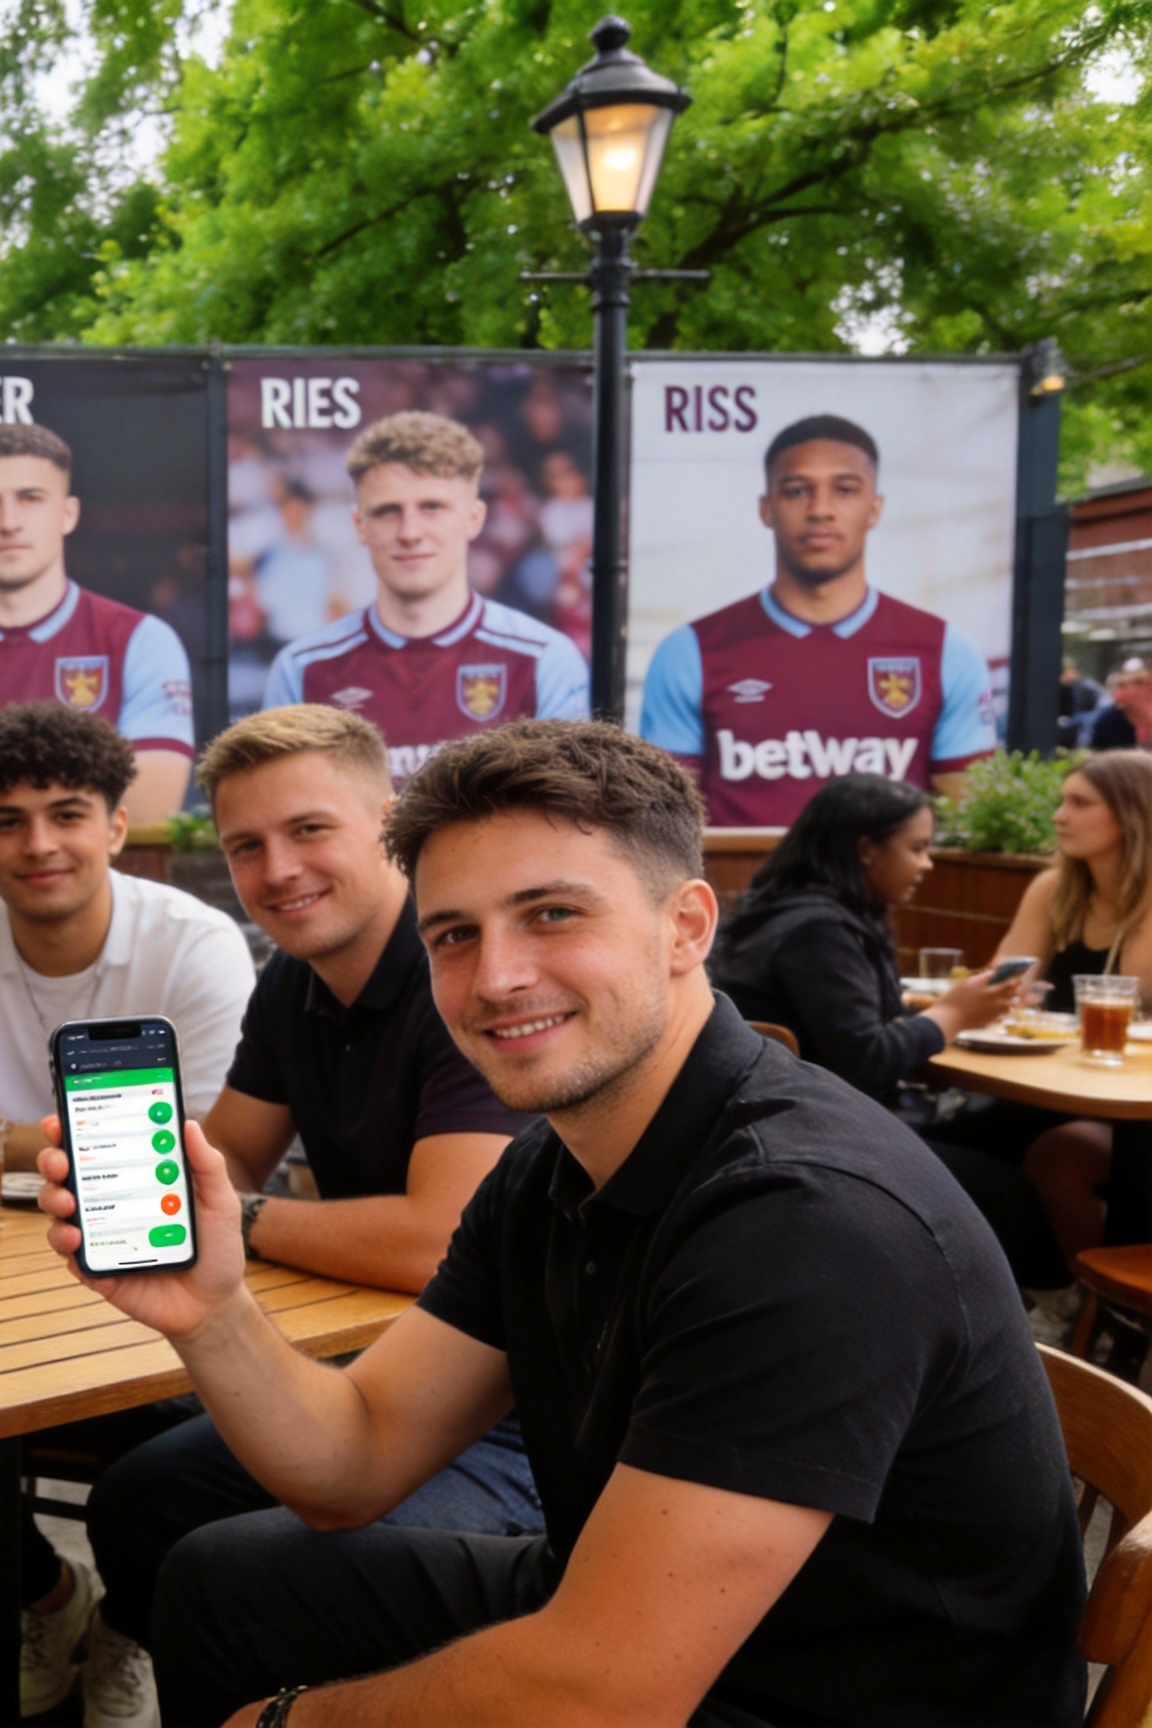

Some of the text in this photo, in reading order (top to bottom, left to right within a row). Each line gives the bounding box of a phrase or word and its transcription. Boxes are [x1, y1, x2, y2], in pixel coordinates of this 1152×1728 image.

[260, 377, 362, 429] RIES
[664, 386, 758, 432] RISS
[716, 728, 918, 781] betway
